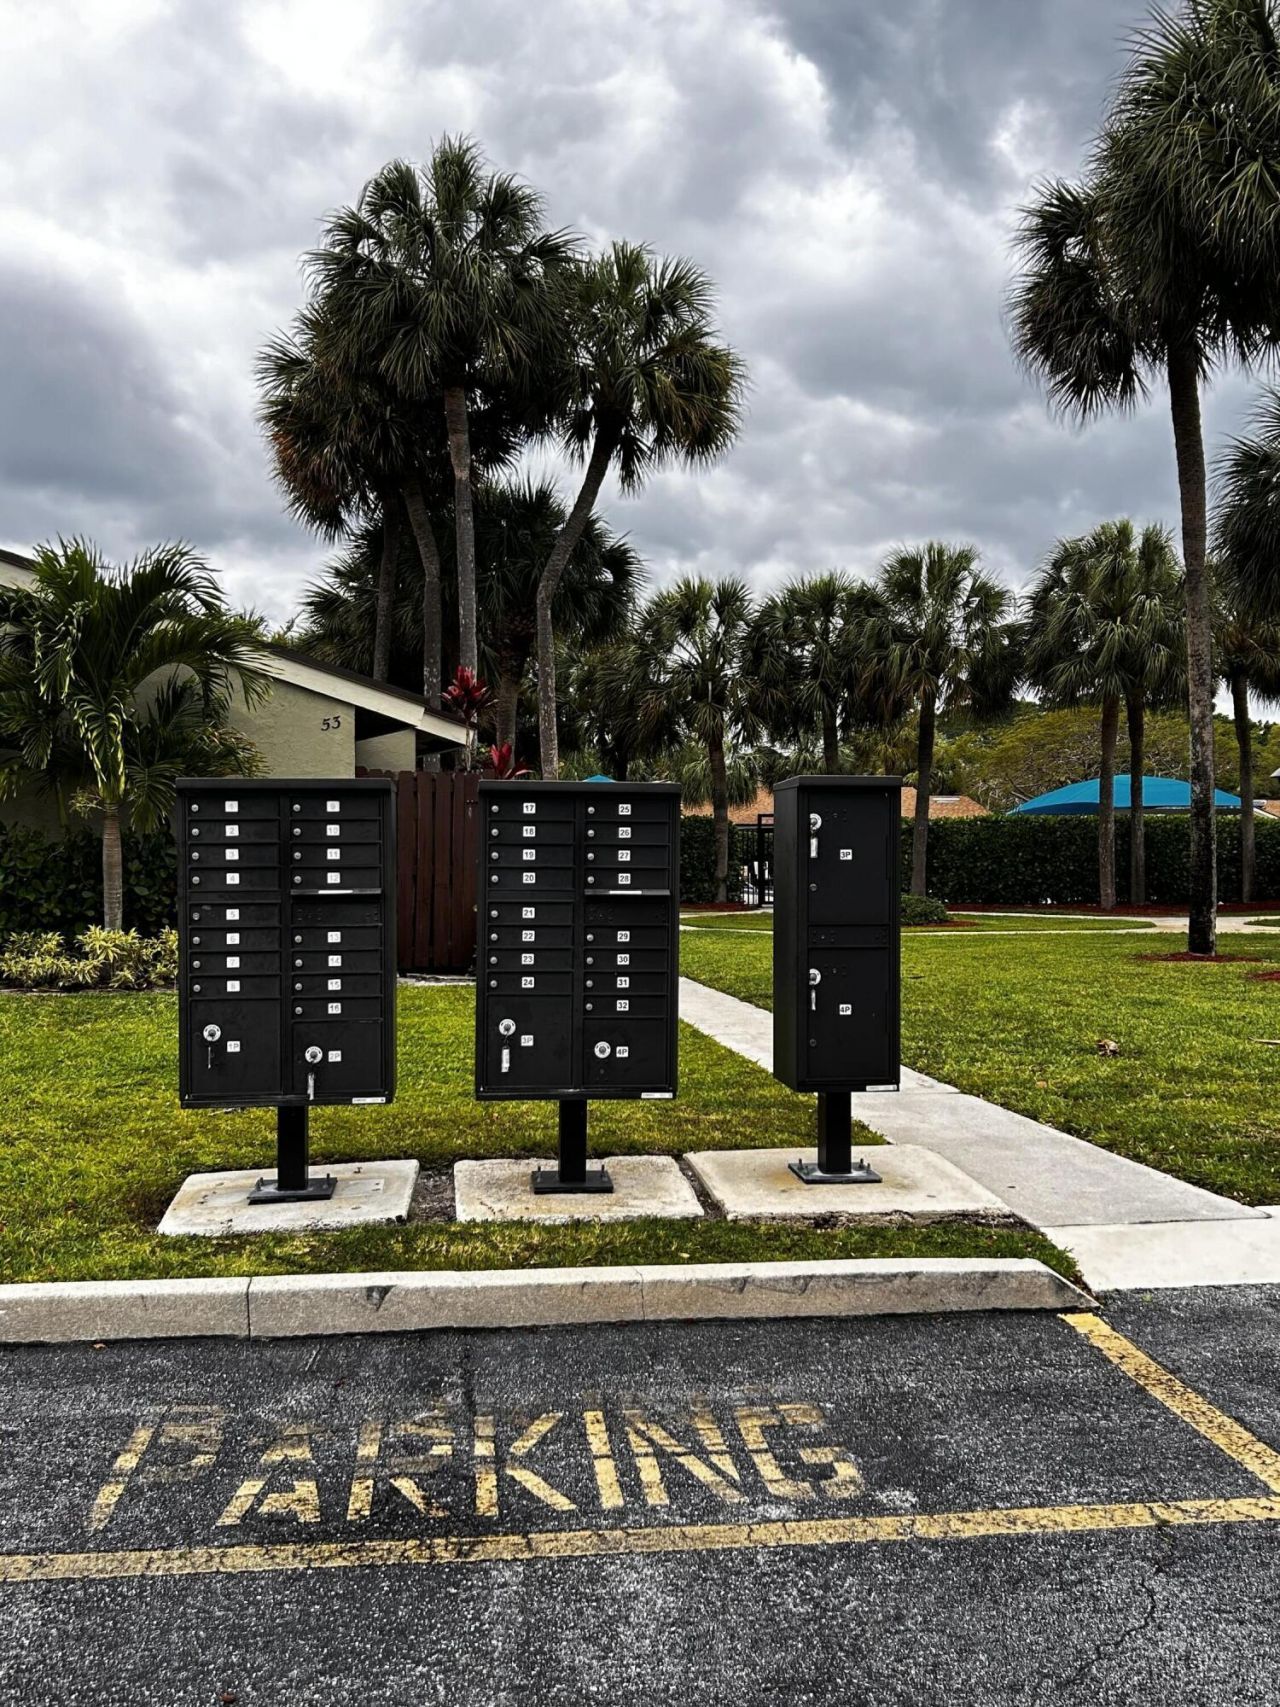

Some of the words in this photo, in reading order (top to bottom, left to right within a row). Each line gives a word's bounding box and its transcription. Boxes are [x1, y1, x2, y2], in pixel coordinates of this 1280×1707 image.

[320, 715, 341, 731] 53
[524, 804, 535, 812] 17
[620, 805, 630, 814] 25
[328, 826, 339, 835] 10
[524, 827, 534, 836] 18
[620, 829, 630, 837] 26
[329, 849, 338, 859] 11
[524, 851, 534, 859] 19
[619, 851, 629, 860] 27
[841, 851, 851, 859] 3P
[329, 873, 339, 883] 12
[524, 874, 534, 882] 20
[620, 874, 630, 883] 28
[524, 909, 533, 917] 21
[329, 933, 340, 942] 13
[523, 932, 534, 940] 22
[619, 932, 629, 940] 29
[330, 957, 340, 965] 14
[523, 955, 533, 963] 23
[618, 955, 628, 964] 30
[329, 980, 340, 990] 15
[523, 978, 533, 986] 24
[618, 978, 628, 986] 31
[329, 1004, 340, 1013] 16
[618, 1001, 628, 1009] 32
[840, 1005, 850, 1013] 4P
[522, 1036, 532, 1046] 3P
[228, 1042, 239, 1052] 1P
[330, 1051, 340, 1061] 2P
[617, 1048, 627, 1056] 4P
[88, 1402, 864, 1532] PARKING
